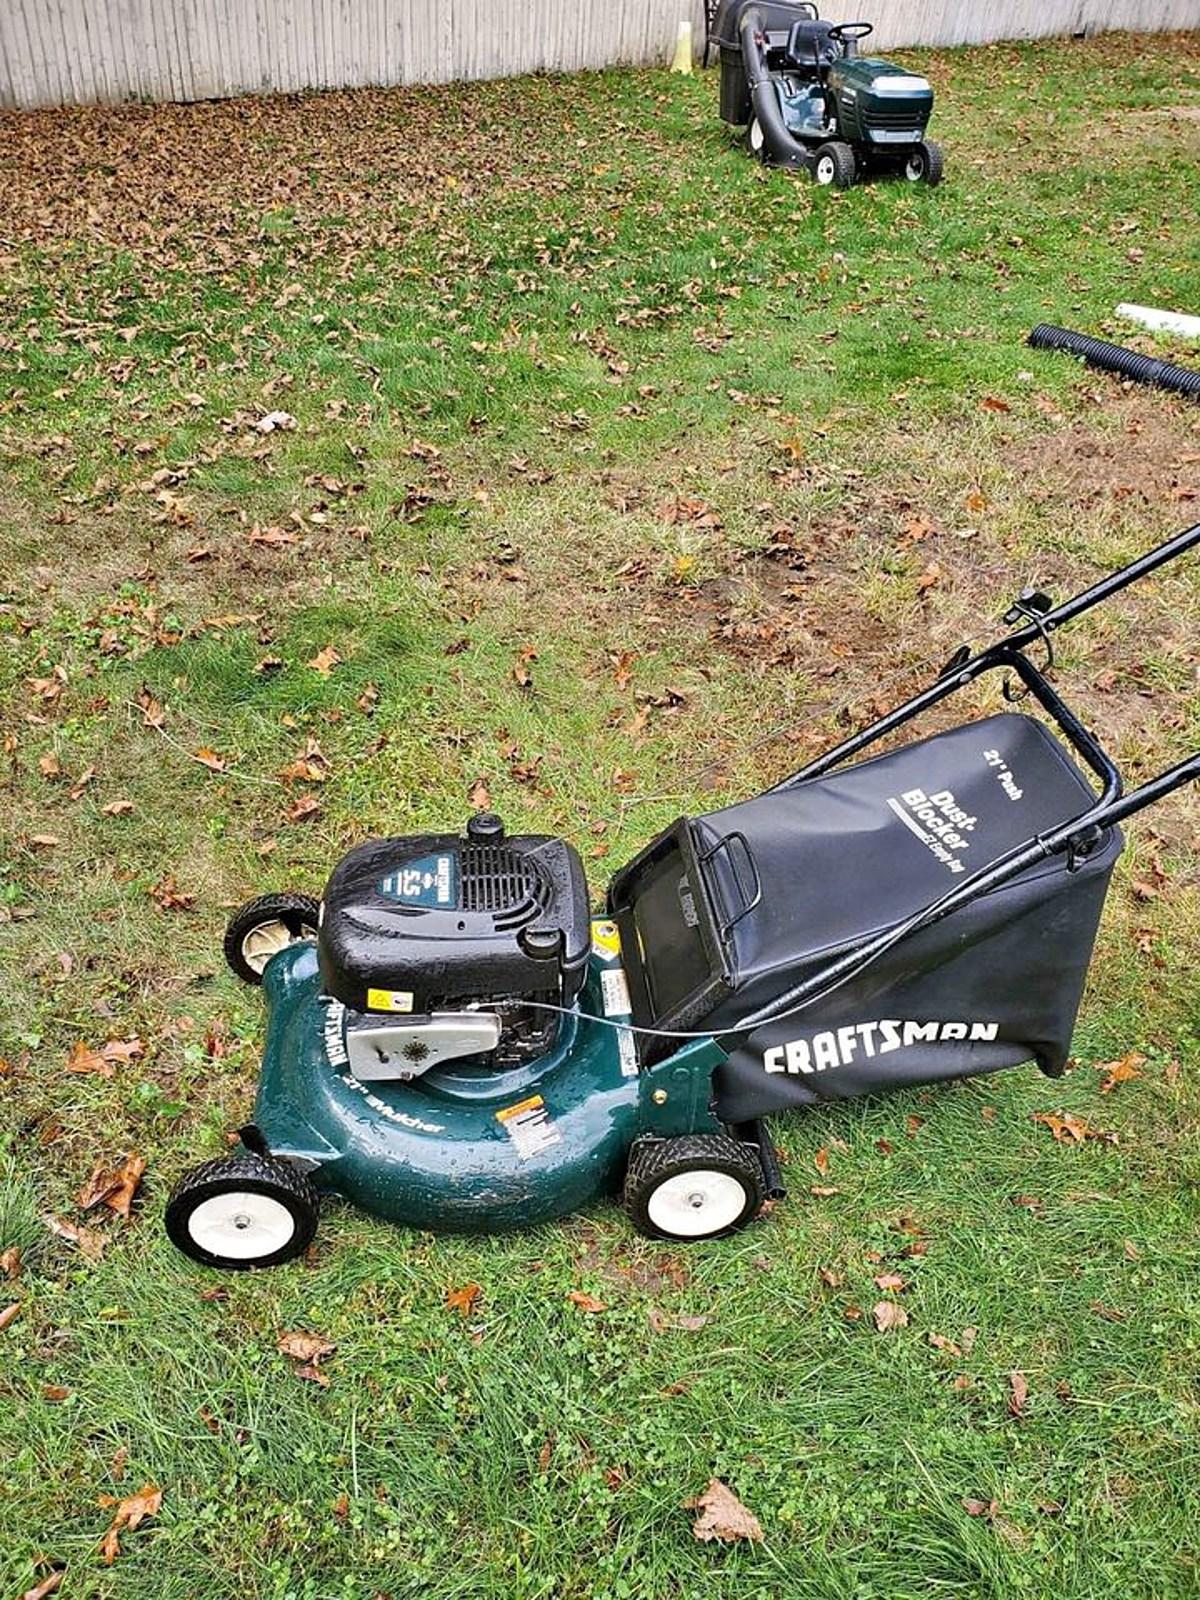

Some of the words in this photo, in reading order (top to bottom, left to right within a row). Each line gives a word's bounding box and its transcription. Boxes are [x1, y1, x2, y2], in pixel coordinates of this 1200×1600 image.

[997, 771, 1024, 801] Push
[901, 788, 969, 849] Blocker
[763, 1020, 999, 1074] CRAFTSMAN
